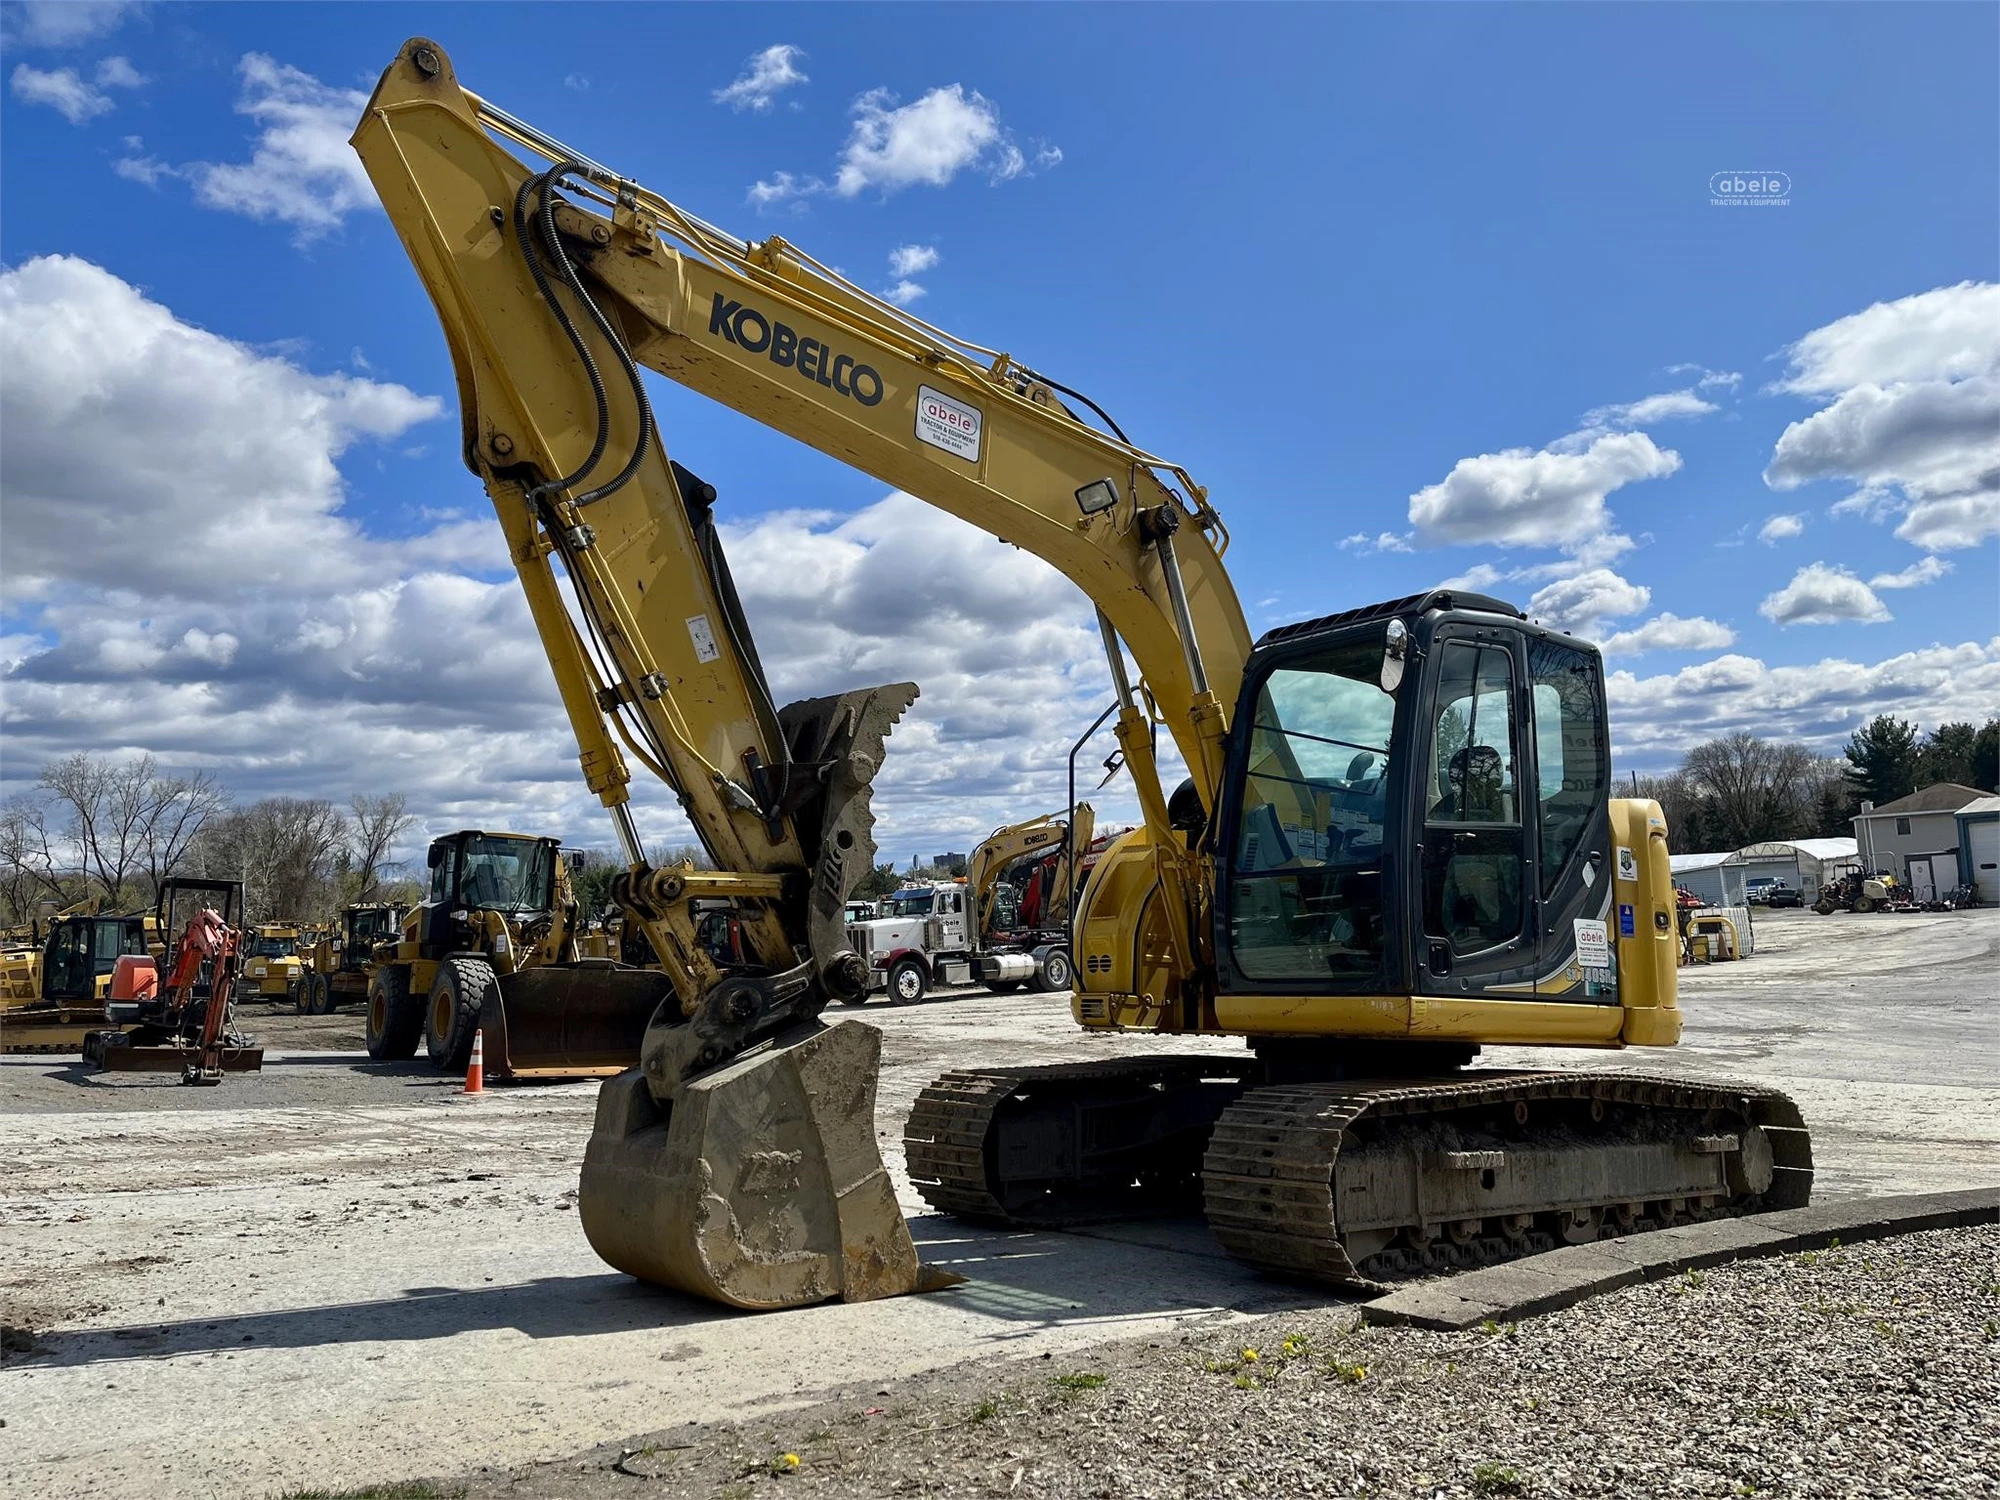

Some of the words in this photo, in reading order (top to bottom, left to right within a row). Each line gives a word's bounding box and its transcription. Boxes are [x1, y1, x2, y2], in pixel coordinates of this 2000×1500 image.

[709, 292, 884, 407] KOBELCO
[920, 416, 943, 433] TRACTOR
[948, 428, 976, 445] EQUIPMENT
[928, 404, 971, 431] abele
[1024, 833, 1048, 846] KOBELCO
[1580, 930, 1603, 943] abele
